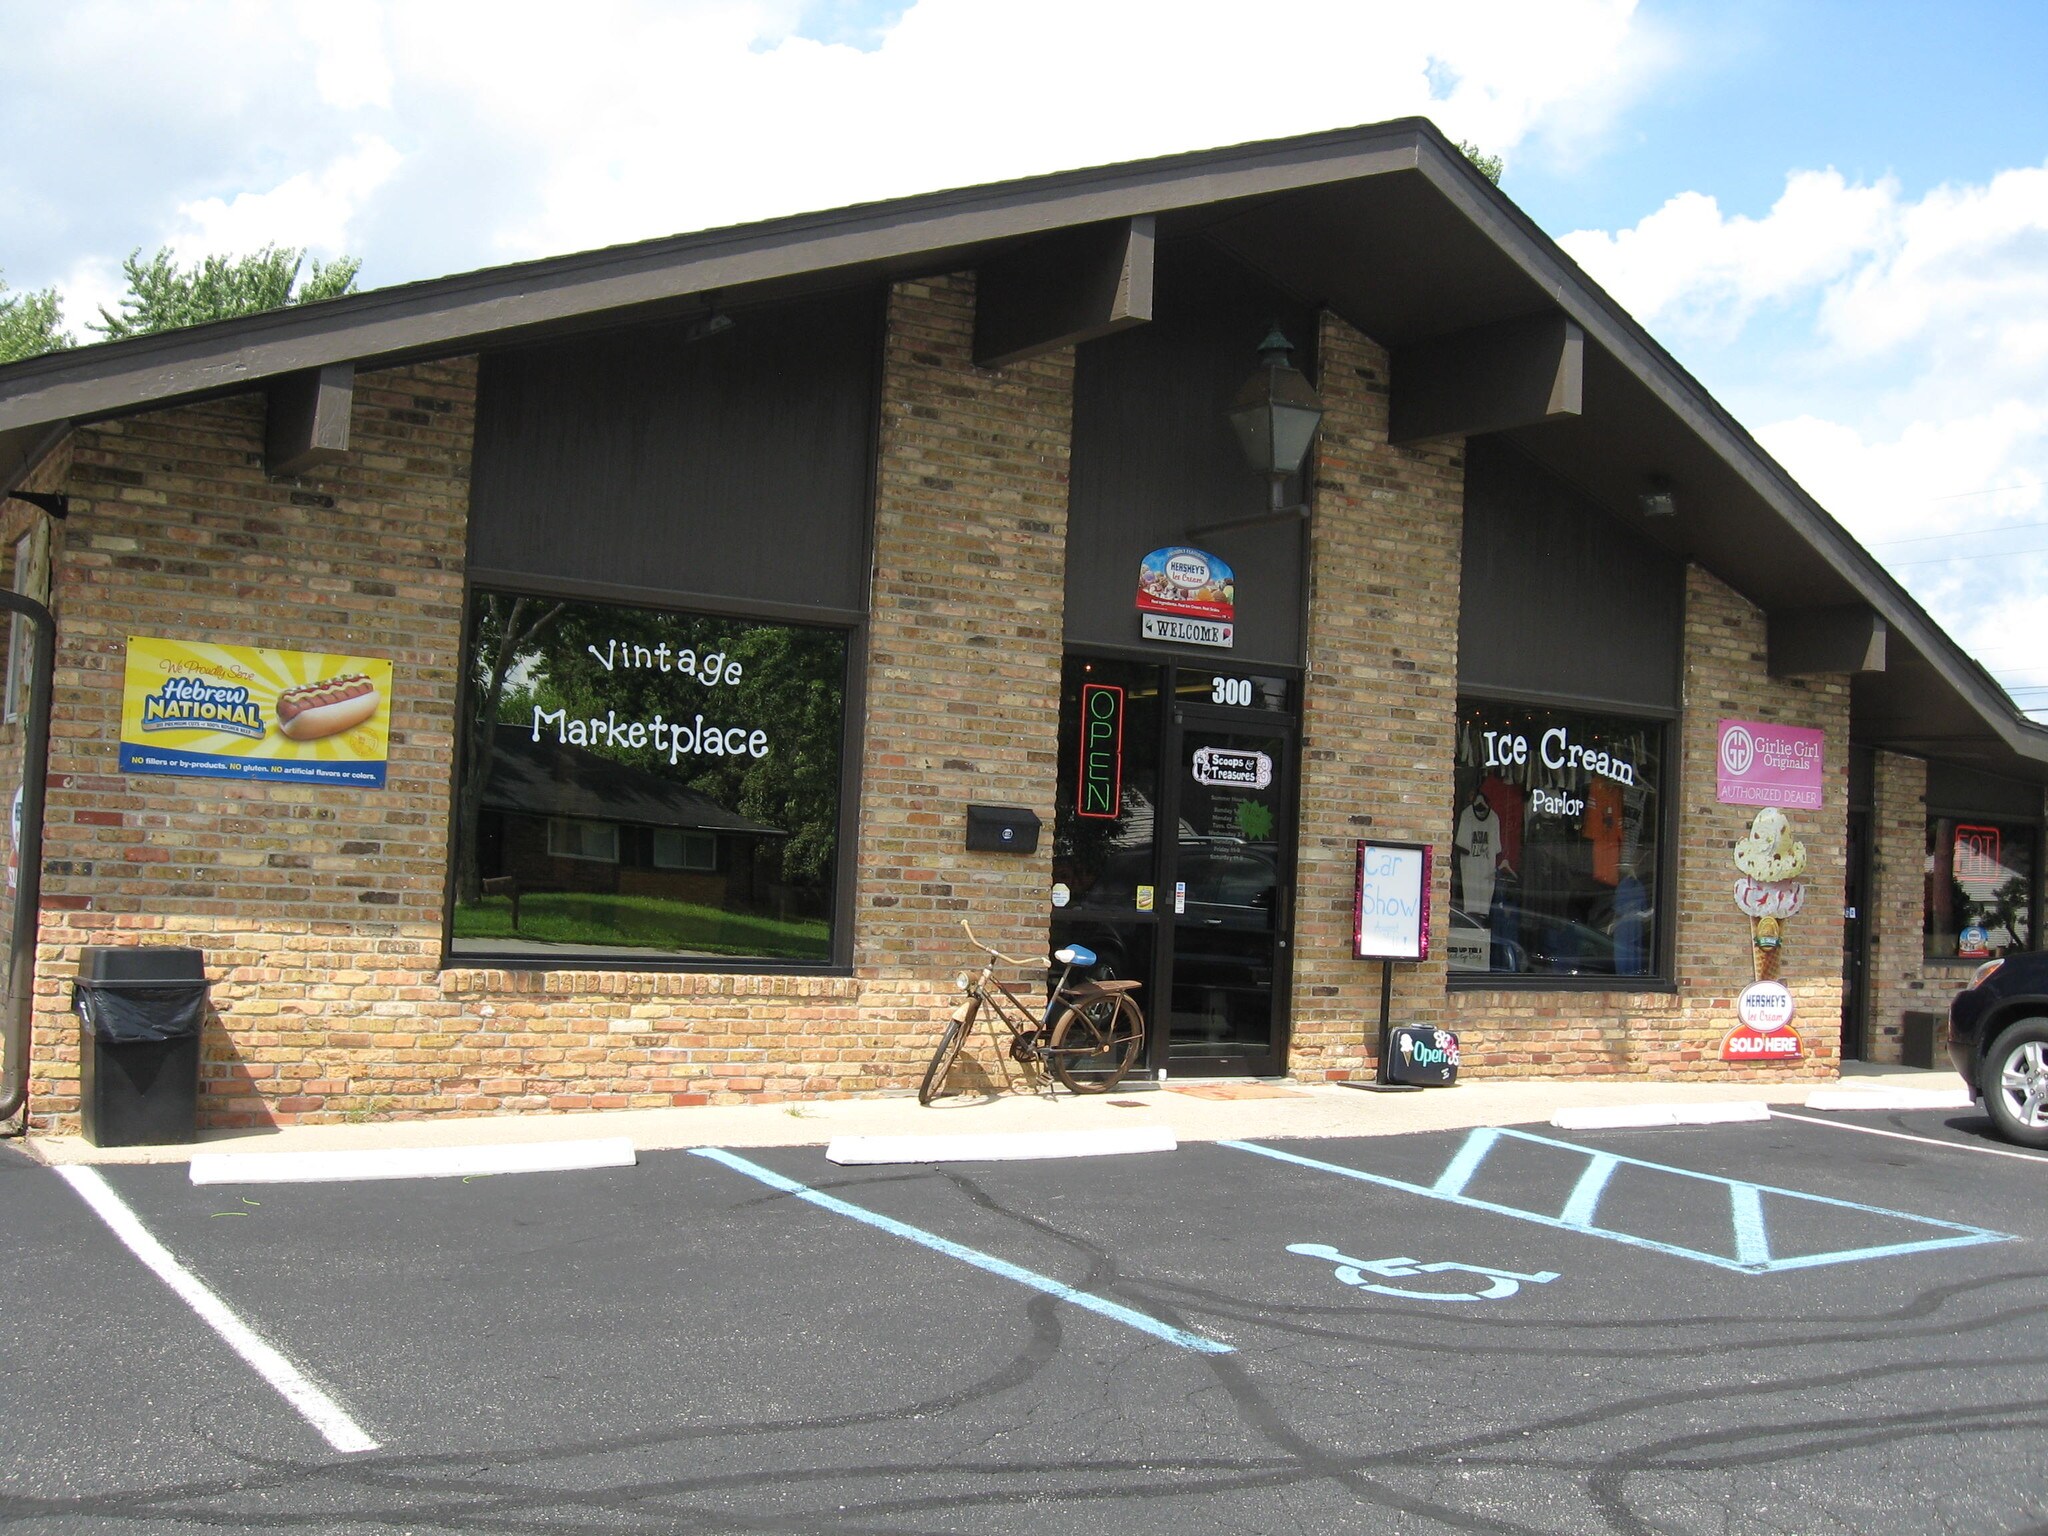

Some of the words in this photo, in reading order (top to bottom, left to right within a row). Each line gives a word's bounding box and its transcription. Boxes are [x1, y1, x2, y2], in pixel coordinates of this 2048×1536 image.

[1171, 562, 1205, 575] HERSHEY'S
[1182, 574, 1203, 584] Cream
[1157, 621, 1219, 642] WELCOME
[160, 659, 183, 674] We
[184, 660, 226, 680] Proudly
[227, 665, 256, 681] Serve
[588, 639, 743, 686] Vintage
[164, 680, 247, 704] Hebrew
[1211, 677, 1252, 707] 300
[147, 698, 260, 729] NATIONAL
[532, 705, 769, 765] Marketplace
[1086, 690, 1115, 812] OPEN
[1483, 731, 1528, 767] Ice
[1540, 726, 1634, 786] Cream
[1754, 737, 1792, 755] Girlie
[1793, 741, 1820, 758] Girl
[131, 756, 144, 764] NO
[145, 757, 168, 766] fillers
[179, 759, 228, 770] by-products.
[229, 763, 242, 771] NO
[243, 764, 269, 773] gluten.
[284, 767, 315, 775] artificial
[316, 769, 341, 777] flavors
[351, 772, 376, 780] colors.
[1211, 754, 1244, 769] Scoops
[1244, 759, 1255, 771] &
[1211, 766, 1256, 782] Treasures
[1763, 754, 1810, 771] Originals
[1532, 789, 1584, 816] Parlor
[1721, 786, 1781, 801] AUTHORIZED
[1784, 790, 1817, 804] DEALER
[1364, 847, 1403, 877] Car
[1362, 883, 1418, 917] Show
[1746, 994, 1786, 1008] HERSHEY'S
[1747, 1010, 1757, 1022] Ice
[1759, 1010, 1783, 1022] Cream
[1413, 1040, 1447, 1067] Open
[1729, 1037, 1764, 1053] SOLD
[1765, 1037, 1797, 1052] HERE
